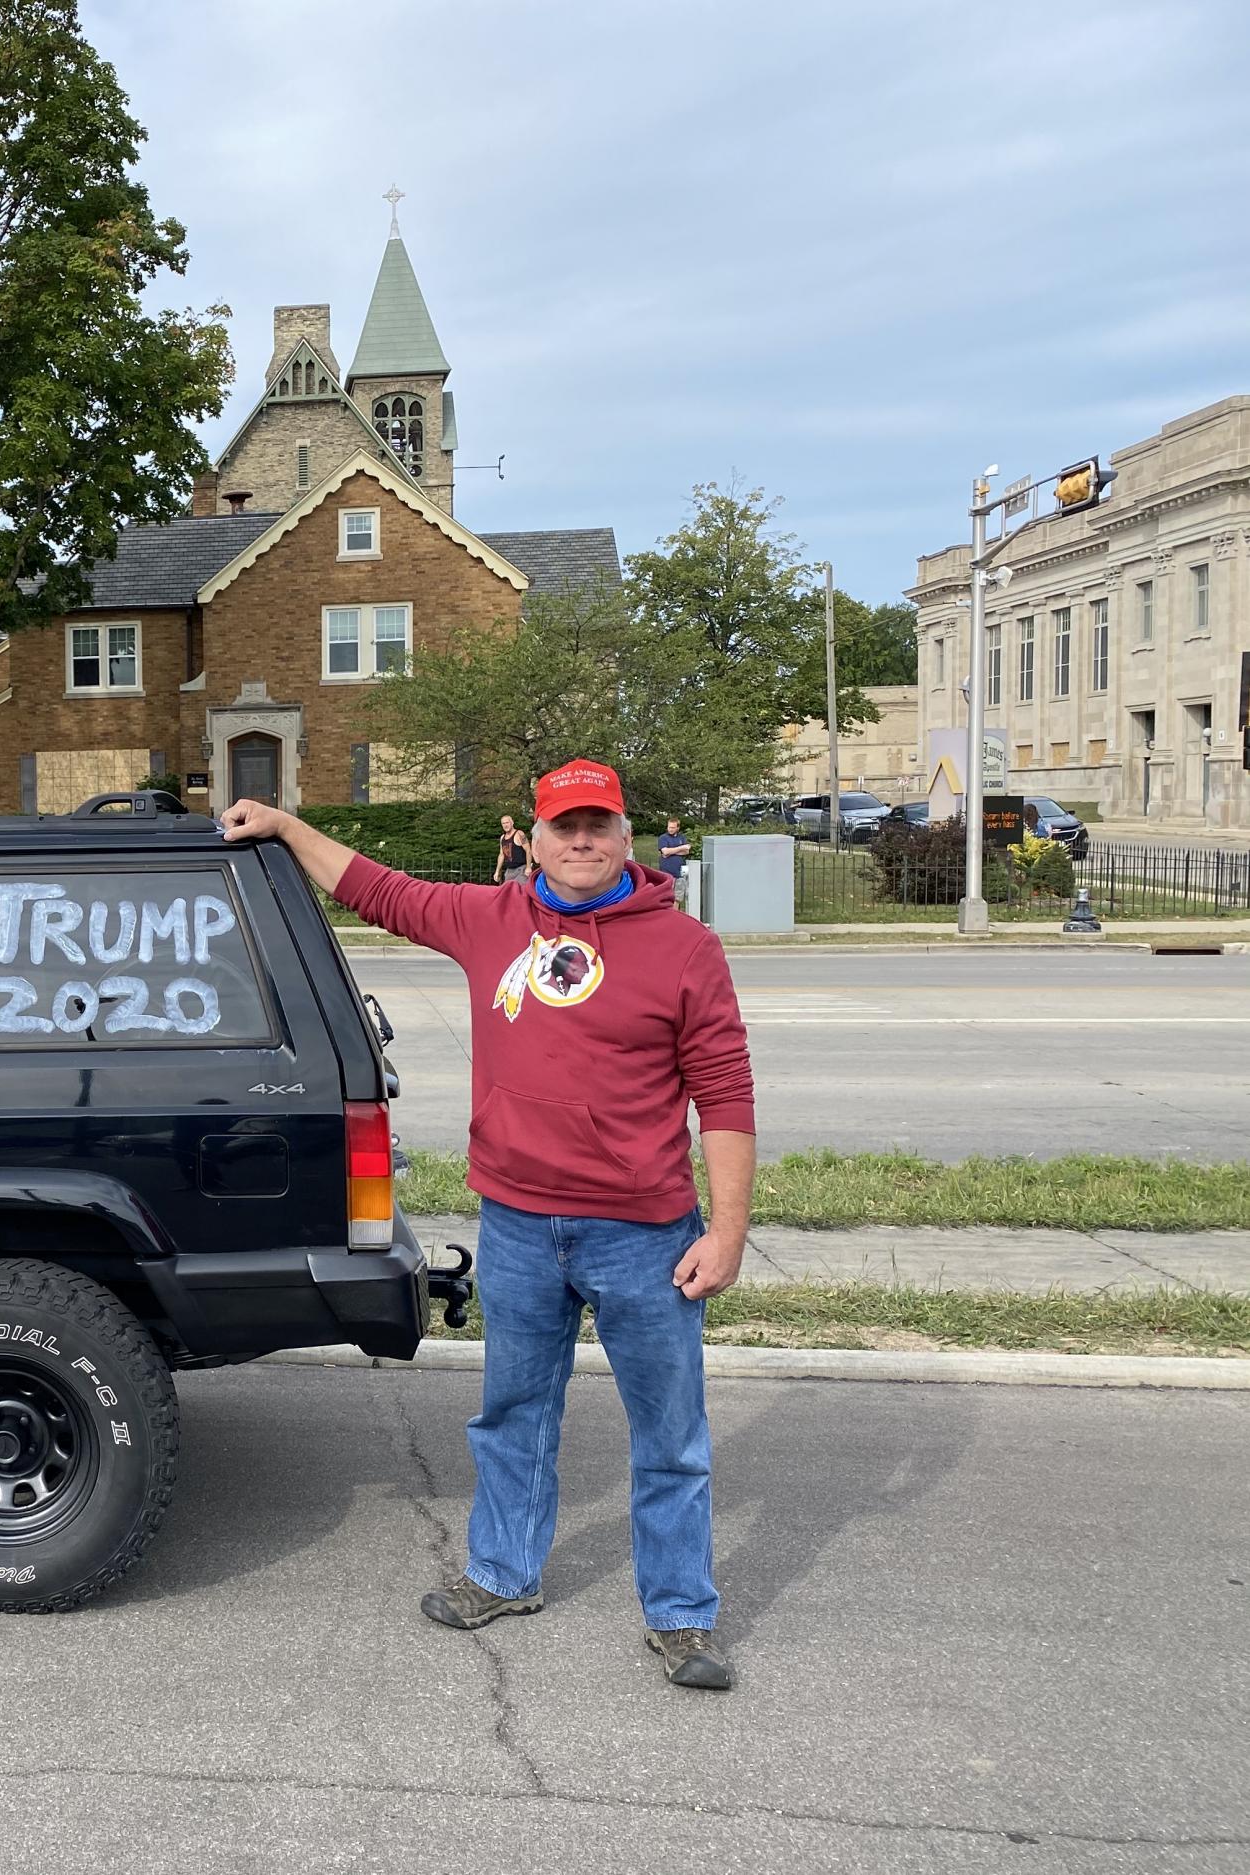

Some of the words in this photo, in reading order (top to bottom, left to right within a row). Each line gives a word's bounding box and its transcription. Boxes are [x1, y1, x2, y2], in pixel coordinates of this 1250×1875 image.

[550, 771, 572, 782] MAKE
[574, 769, 609, 781] AMERICA
[552, 777, 581, 788] GREAT
[582, 778, 606, 788] AGAIN
[71, 1355, 119, 1408] F-C
[110, 1421, 131, 1446] II
